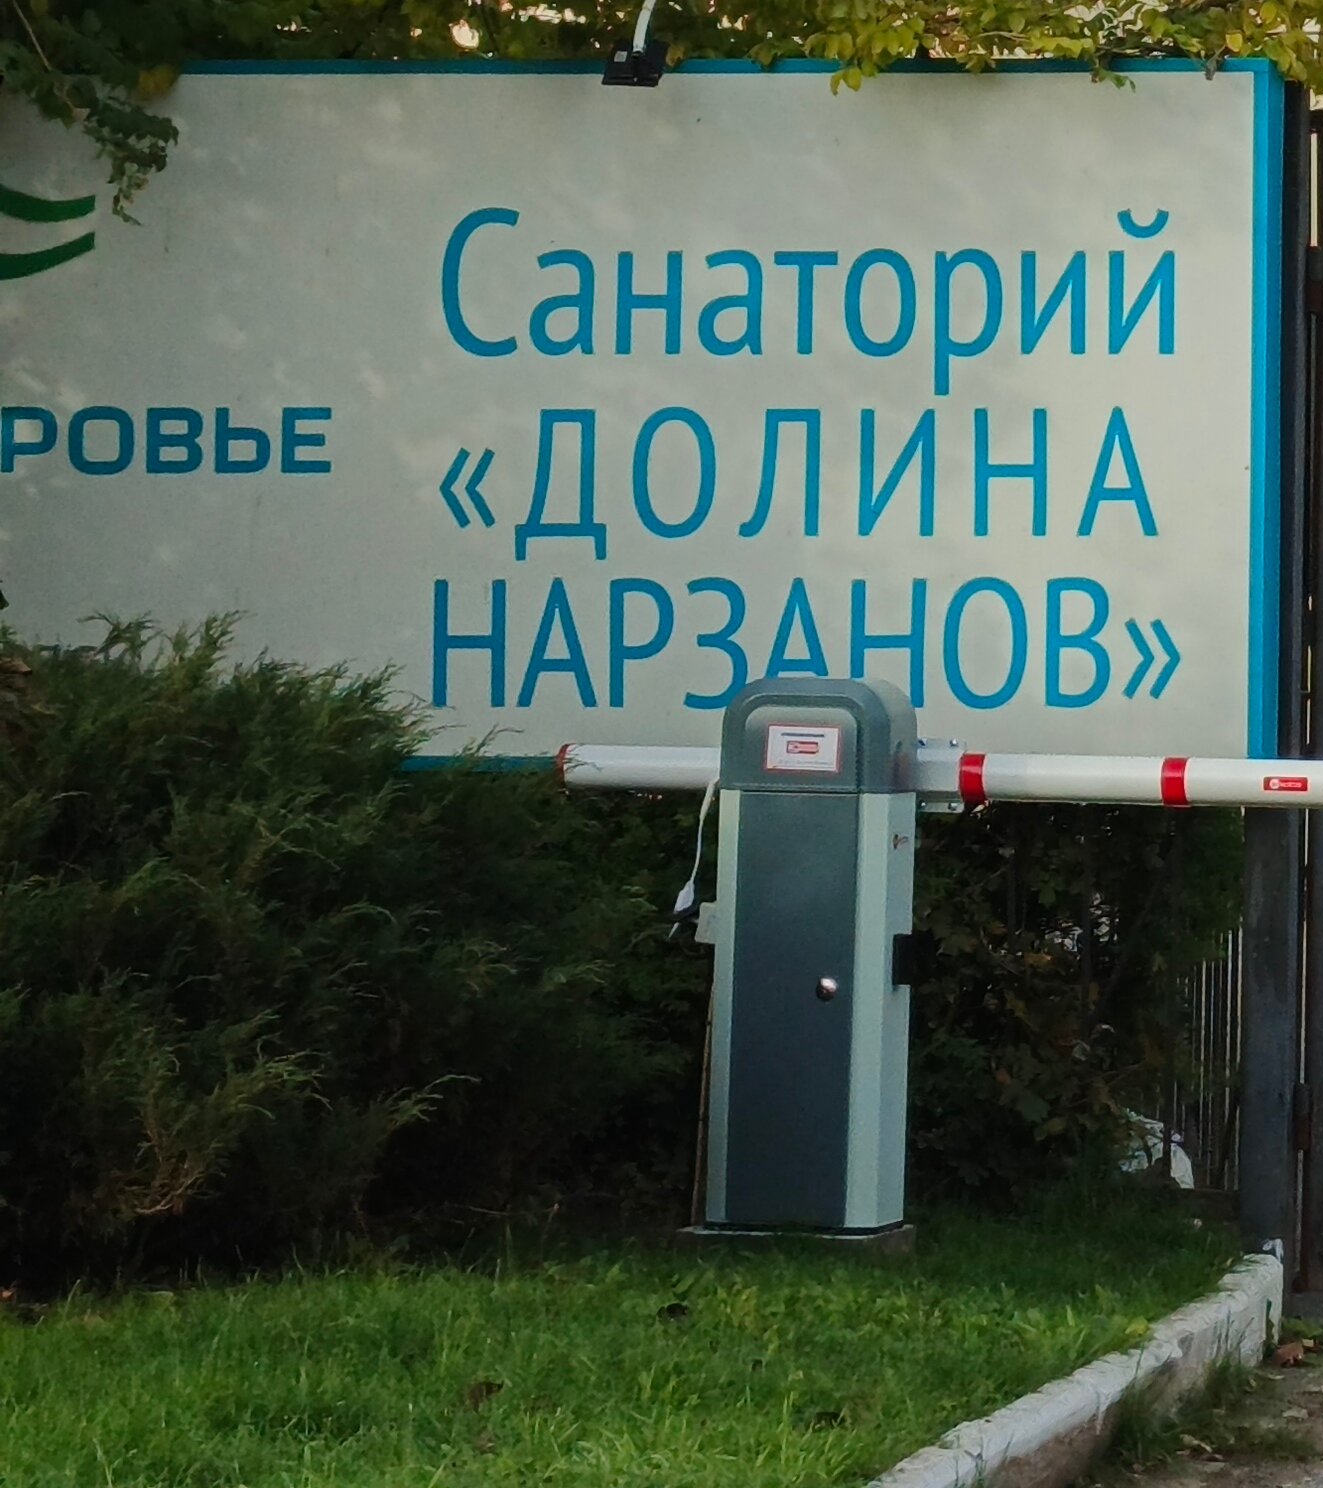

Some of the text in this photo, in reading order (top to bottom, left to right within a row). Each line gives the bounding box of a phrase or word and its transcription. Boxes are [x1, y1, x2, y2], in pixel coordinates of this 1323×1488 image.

[441, 206, 1177, 396] Санаторий
[0, 405, 333, 475] РОВЬЕ
[439, 406, 1159, 561] «ДОЛИНА
[432, 576, 1182, 709] НАРЗАНОВ»
